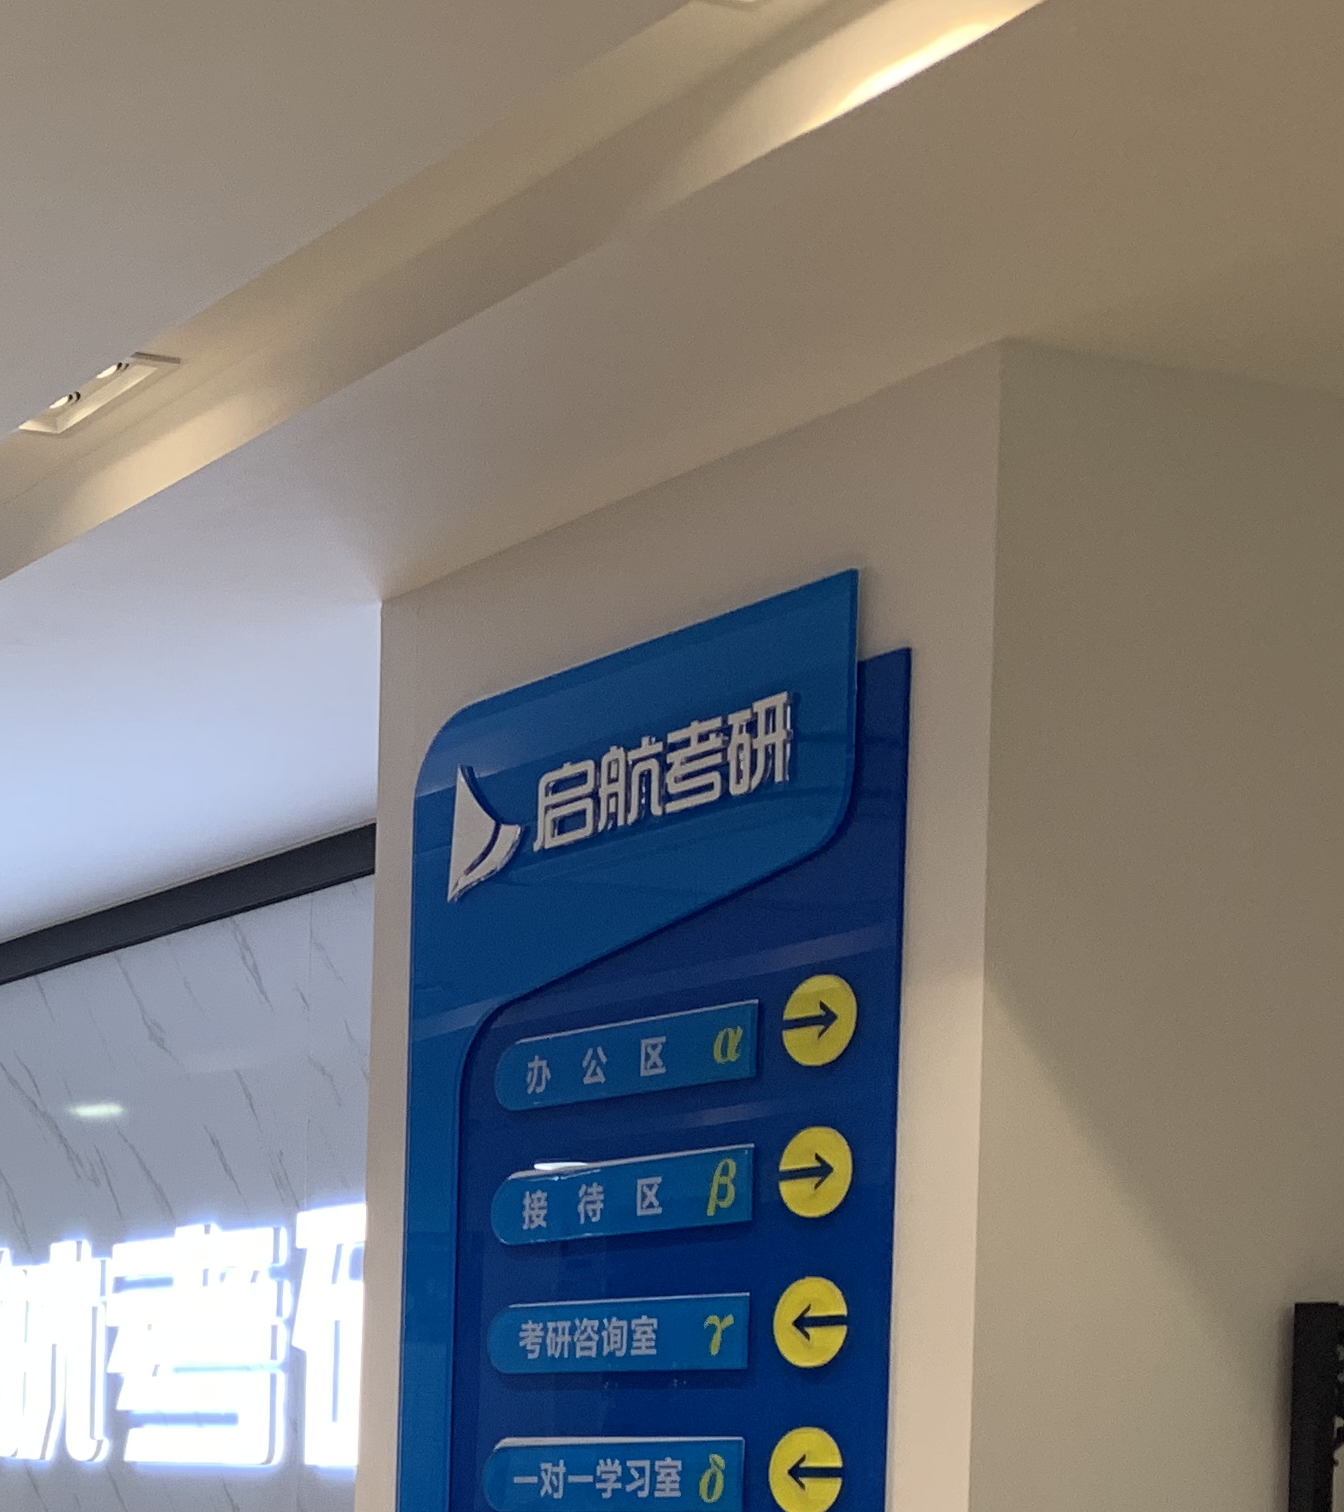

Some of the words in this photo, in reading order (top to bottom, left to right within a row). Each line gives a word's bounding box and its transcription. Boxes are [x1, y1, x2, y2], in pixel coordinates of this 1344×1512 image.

[533, 691, 793, 851] 启航考研
[524, 1036, 668, 1095] 办公区
[521, 1176, 664, 1230] 接待区
[518, 1315, 659, 1360] 考研咨询室
[512, 1457, 683, 1499] 一对一学习室
